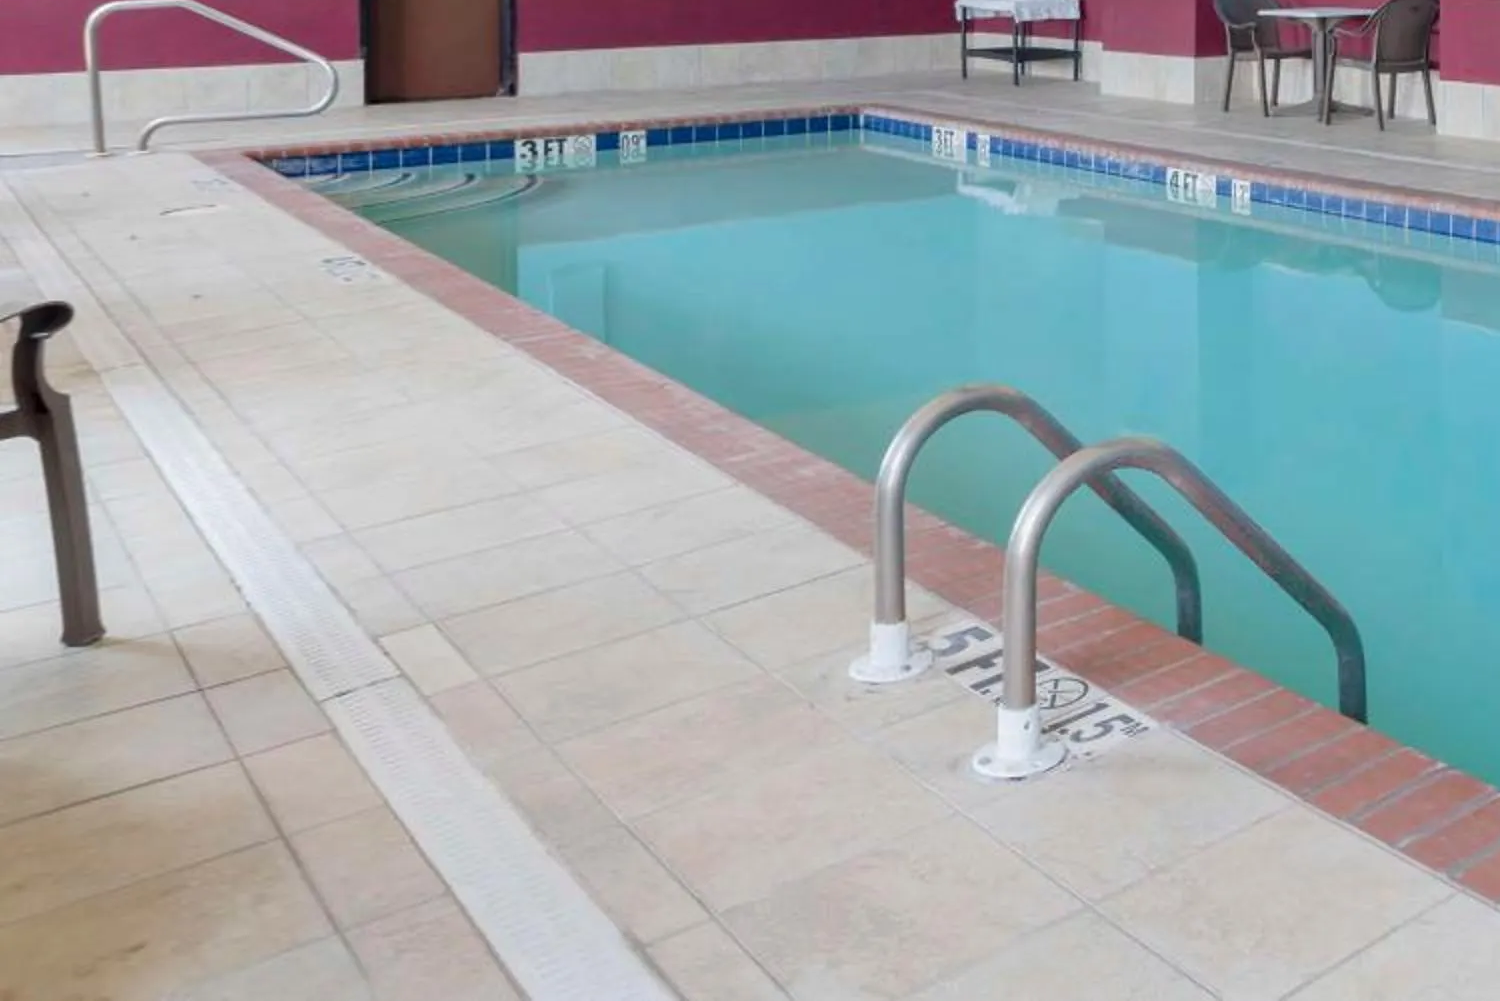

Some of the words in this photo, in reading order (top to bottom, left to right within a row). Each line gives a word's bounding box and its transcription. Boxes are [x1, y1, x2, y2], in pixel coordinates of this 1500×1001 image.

[520, 140, 538, 156] 3
[543, 138, 567, 155] FT
[915, 626, 993, 657] 5
